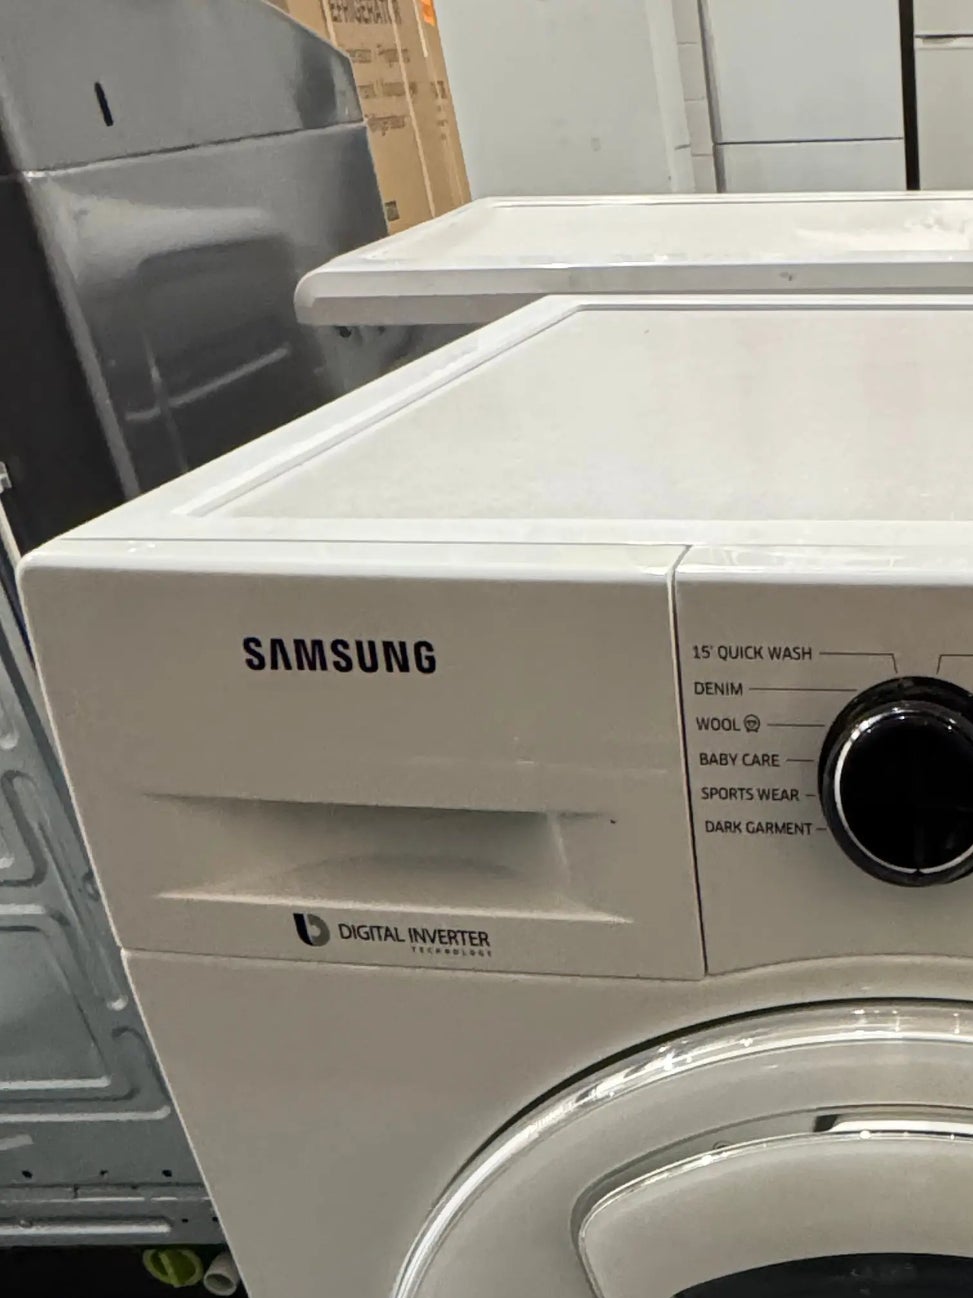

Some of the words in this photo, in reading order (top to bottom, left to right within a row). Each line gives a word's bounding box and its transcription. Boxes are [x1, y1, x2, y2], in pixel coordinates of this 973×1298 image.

[243, 637, 436, 674] SAMSUNG
[717, 645, 764, 661] QUICK
[767, 646, 813, 661] WASH
[693, 681, 743, 696] DENIM
[696, 716, 741, 732] WOOL
[699, 752, 738, 767] BABY
[742, 753, 781, 768] CARE
[701, 786, 754, 801] SPORTS
[757, 787, 800, 802] WEAR
[705, 819, 742, 834] DARK
[745, 821, 813, 836] GARMENT
[338, 923, 405, 943] DIGITAL
[408, 927, 491, 948] INVERTER
